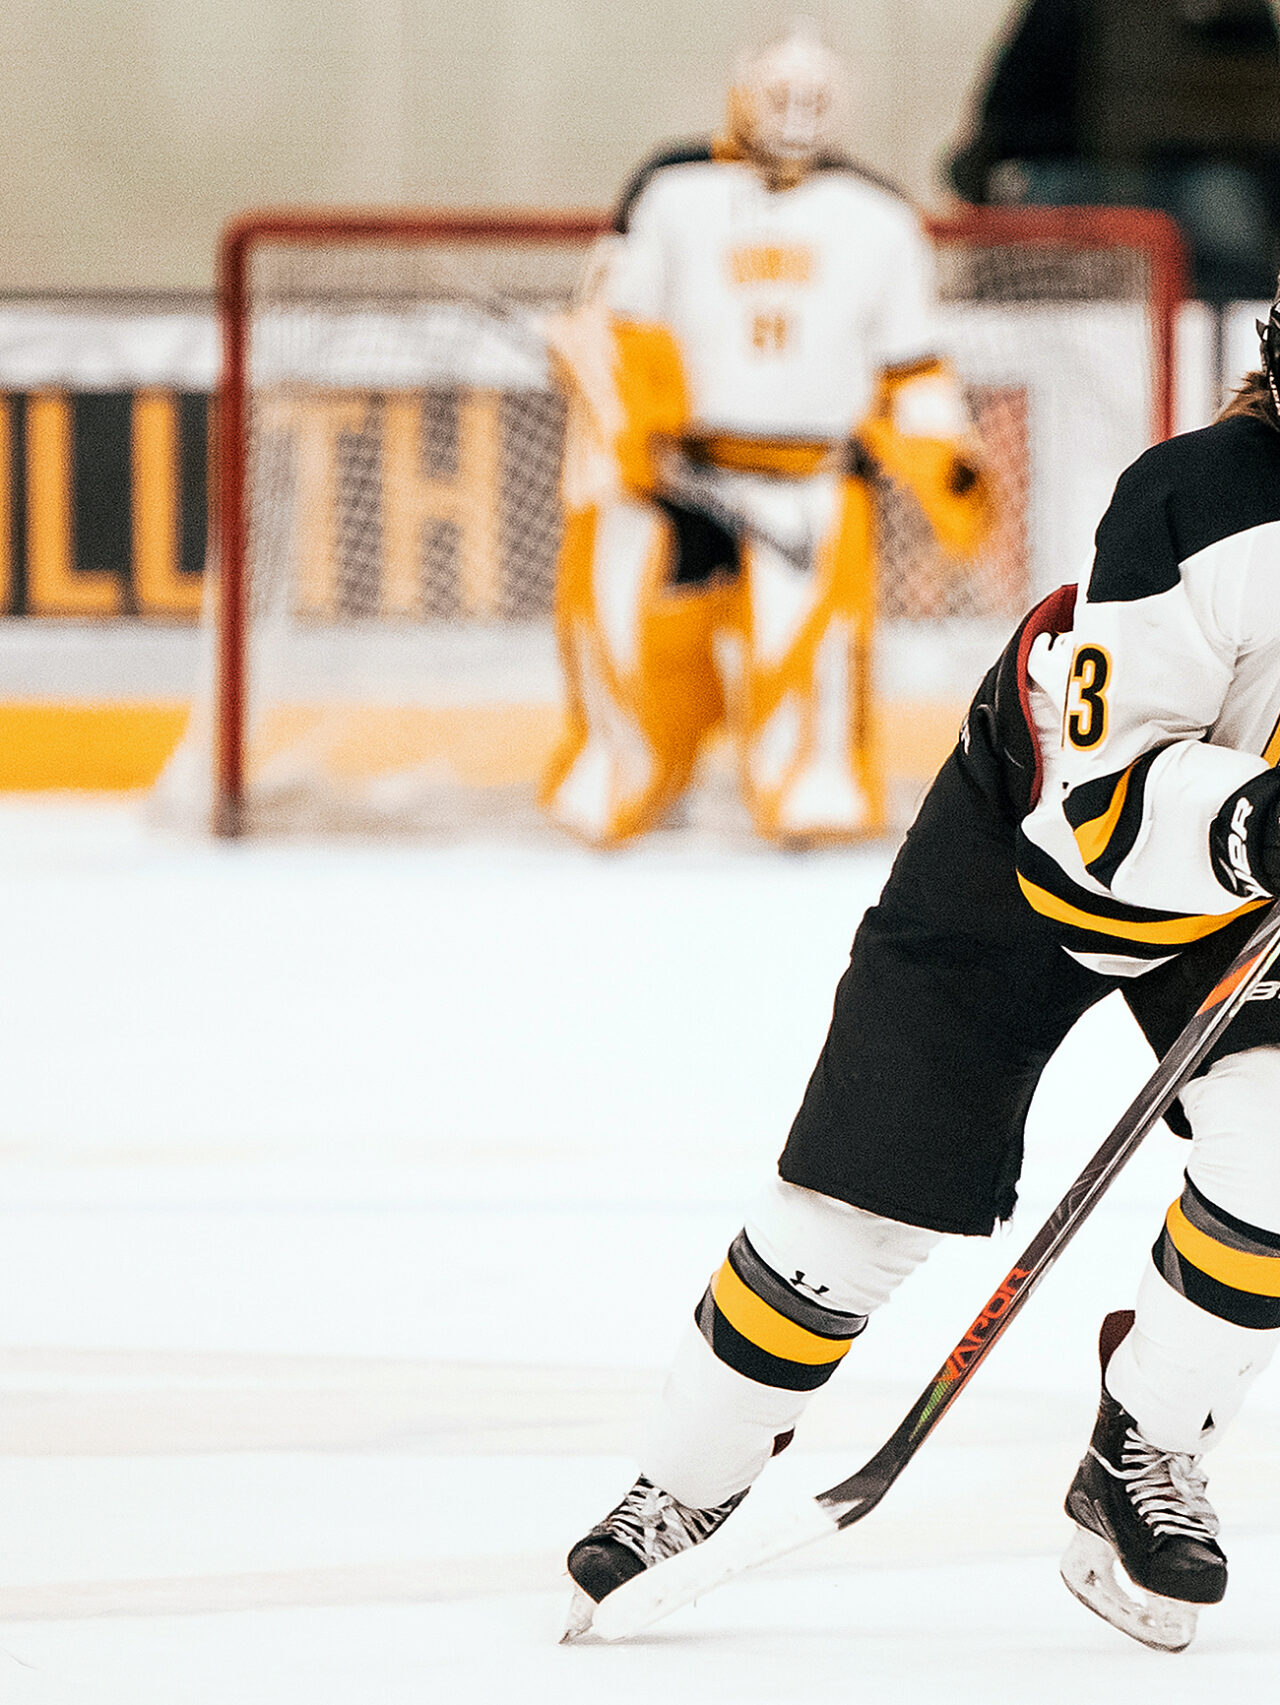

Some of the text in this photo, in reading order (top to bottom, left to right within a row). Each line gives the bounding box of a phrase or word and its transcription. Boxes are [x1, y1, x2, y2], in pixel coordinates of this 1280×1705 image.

[0, 388, 210, 616] LL
[1061, 642, 1113, 752] 3
[933, 1266, 1035, 1382] VAPOR
